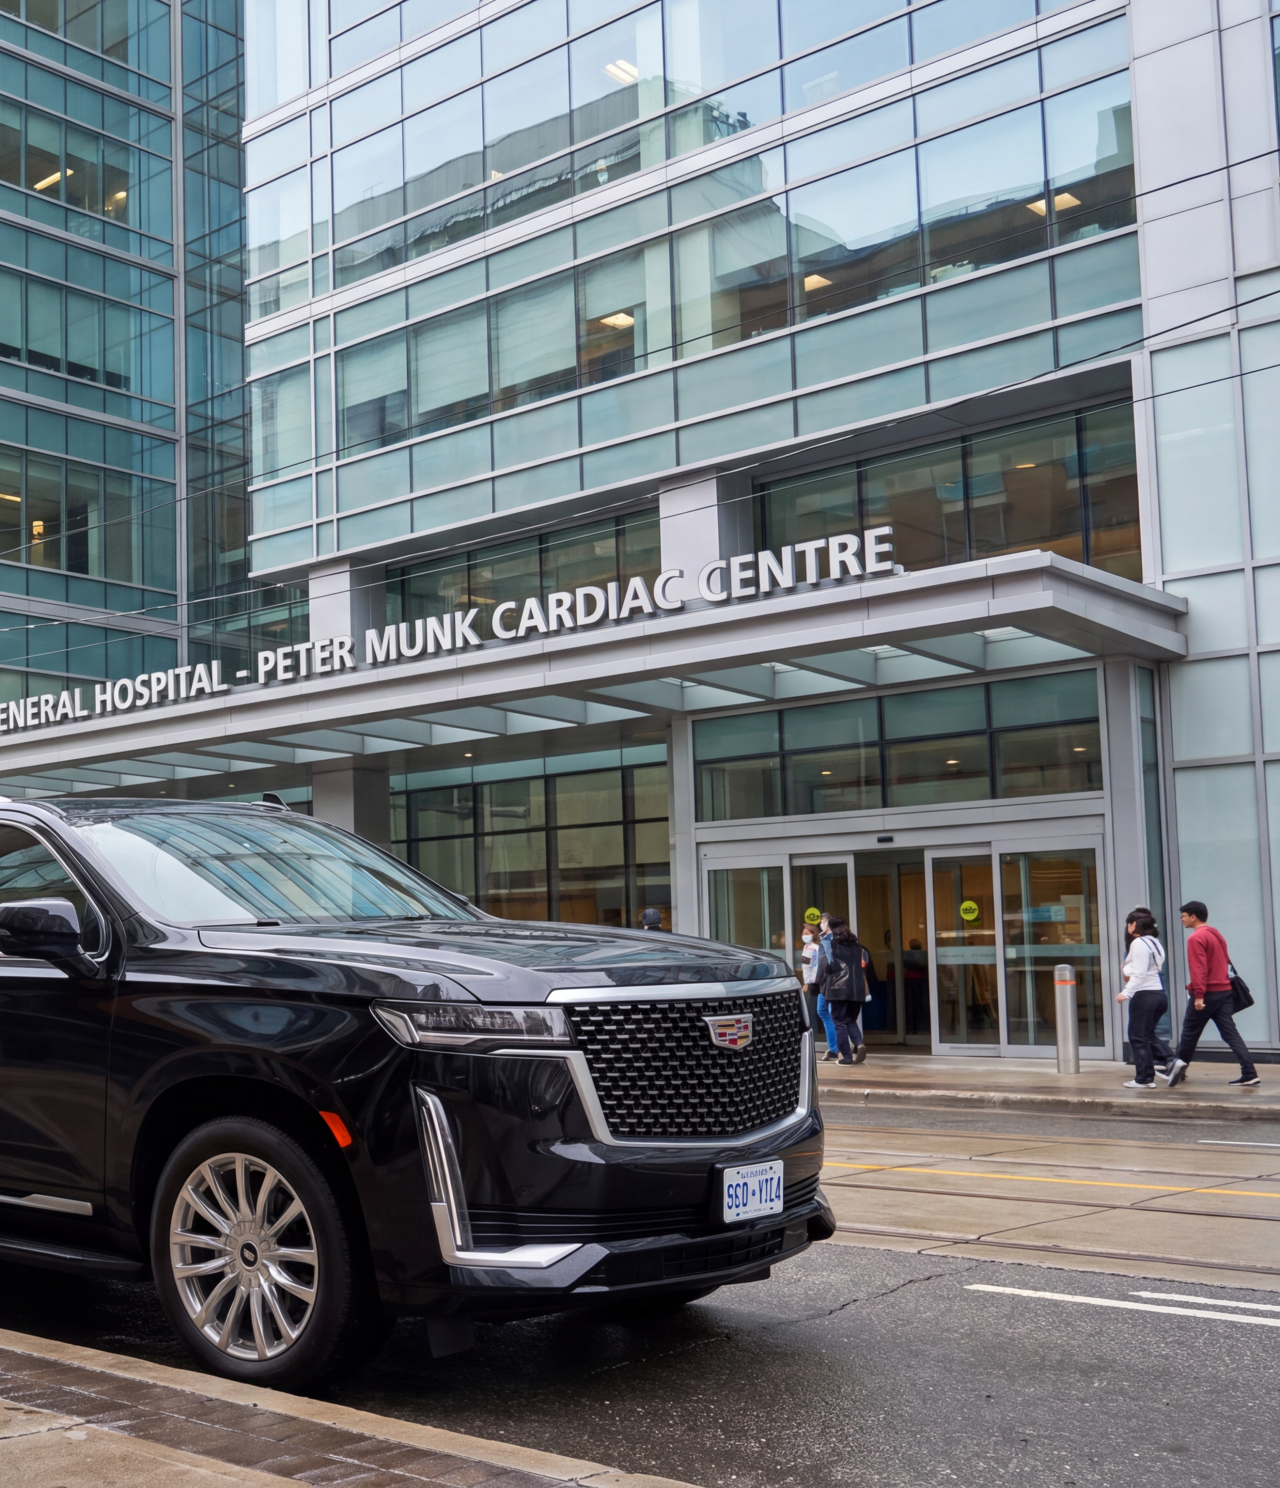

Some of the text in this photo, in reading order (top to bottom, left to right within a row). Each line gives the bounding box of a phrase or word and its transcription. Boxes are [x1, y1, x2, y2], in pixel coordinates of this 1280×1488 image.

[94, 659, 228, 714] HOSPITAL
[257, 635, 357, 684] PETER
[365, 608, 483, 664] MUNK
[491, 568, 686, 640] CARDIAC
[696, 525, 896, 602] CENTRE
